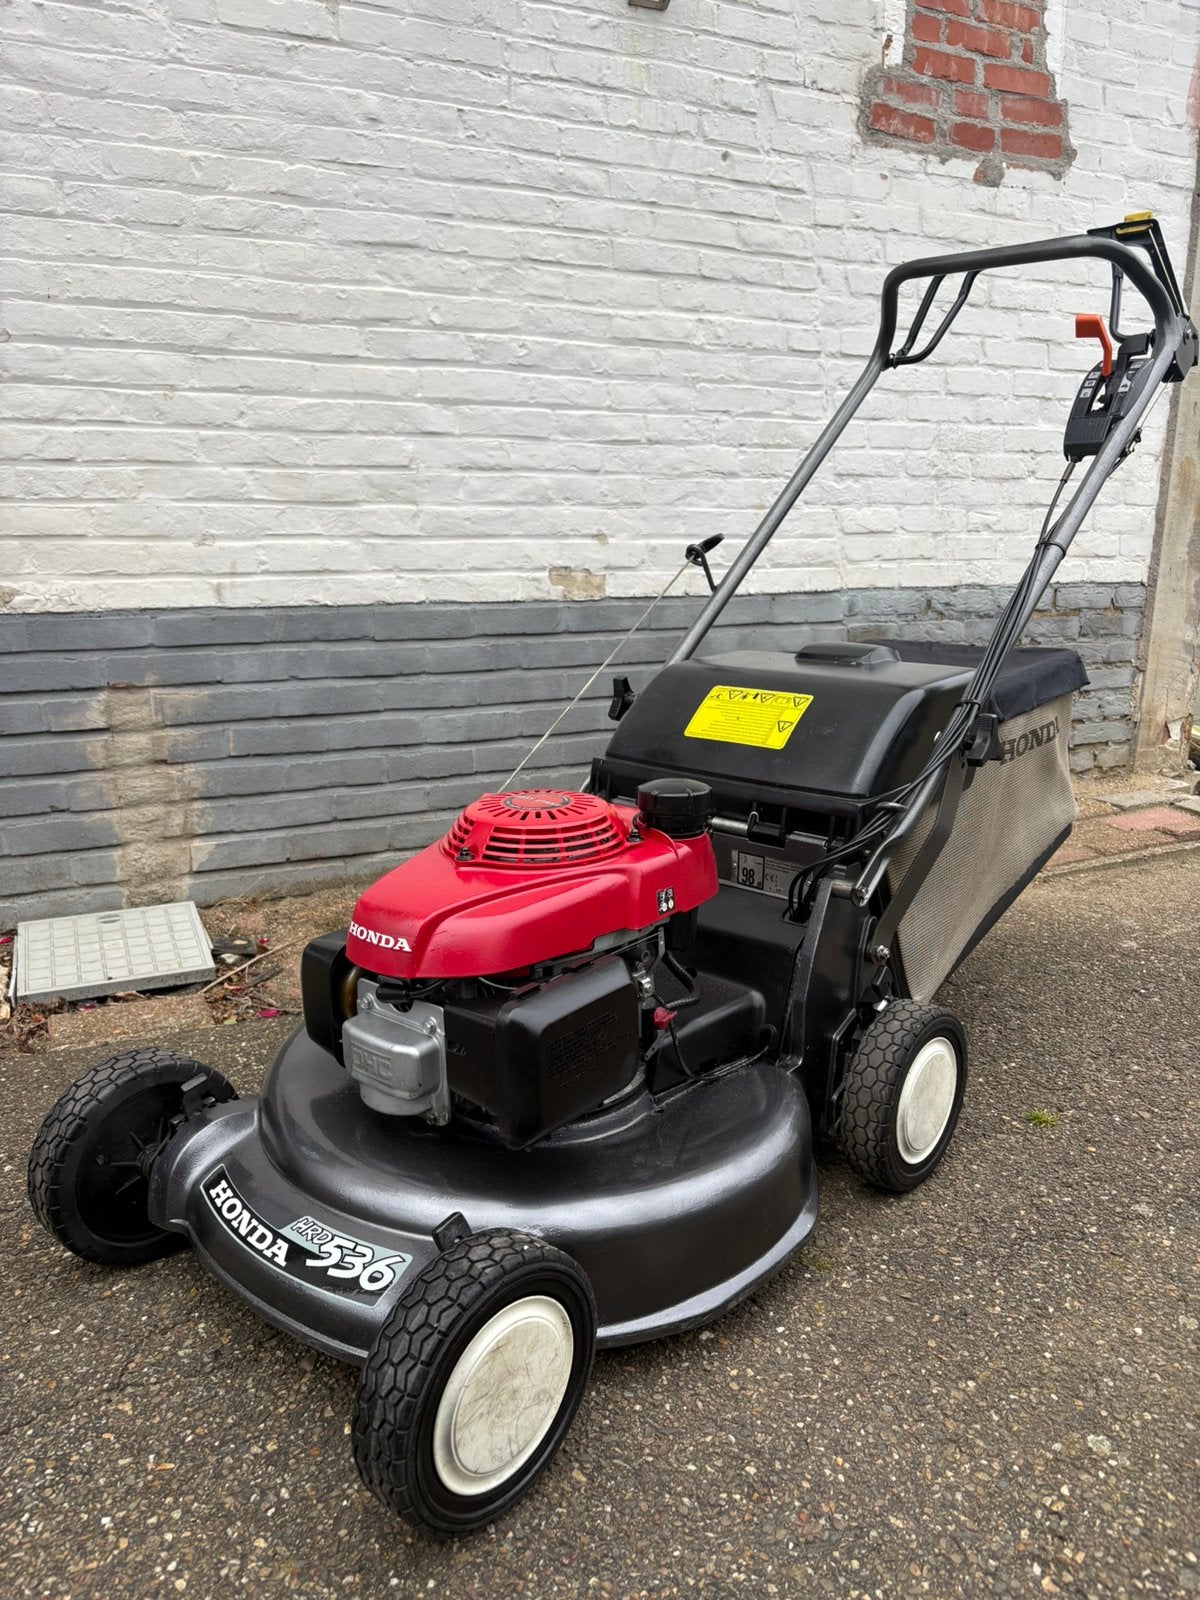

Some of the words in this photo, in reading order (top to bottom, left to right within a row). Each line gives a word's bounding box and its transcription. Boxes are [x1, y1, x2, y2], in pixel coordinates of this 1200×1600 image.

[999, 716, 1060, 766] HOND
[741, 866, 755, 885] 98
[349, 920, 412, 953] HONDA
[209, 1179, 289, 1267] HONDA
[305, 1234, 406, 1292] 536
